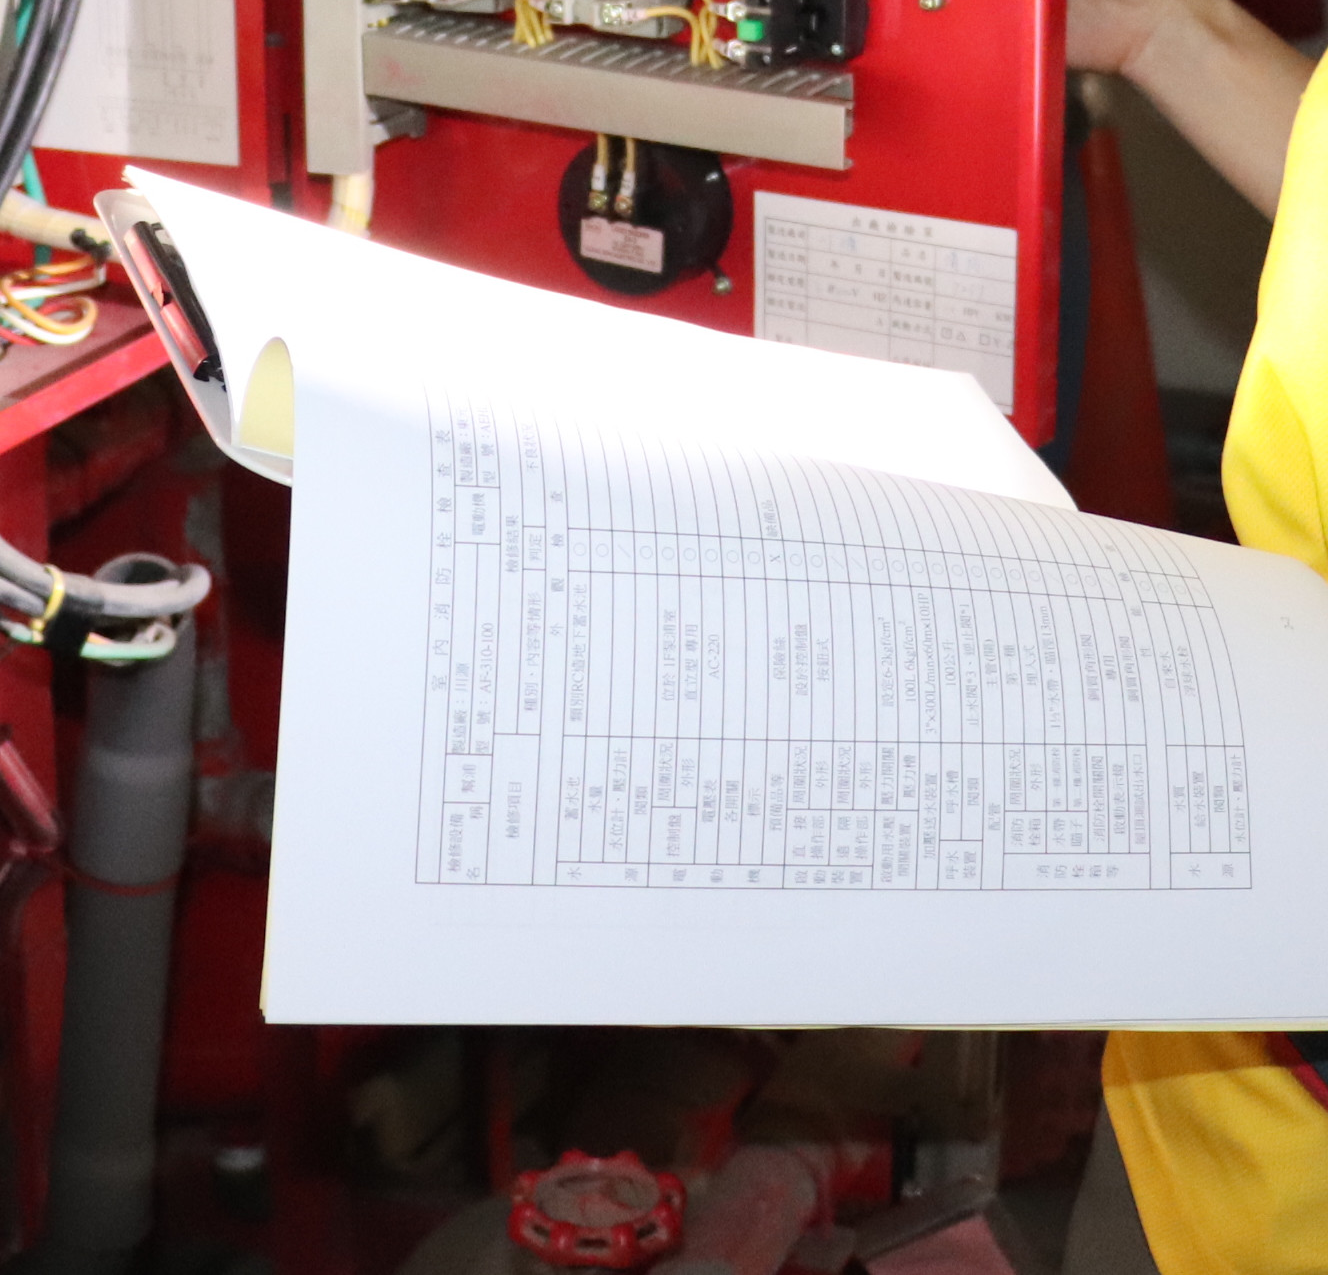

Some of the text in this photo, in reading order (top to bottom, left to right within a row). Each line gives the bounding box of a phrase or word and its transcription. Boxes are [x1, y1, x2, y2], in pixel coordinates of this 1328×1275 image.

[472, 493, 486, 535] 電動機
[505, 515, 520, 573] 檢修結果
[528, 533, 542, 562] 判定
[707, 633, 720, 680] AC-220
[658, 743, 674, 802] 周圍狀況
[681, 758, 695, 787] 外形
[792, 745, 808, 804] 周圍狀況
[815, 760, 829, 789] 外形
[836, 746, 851, 804] 周圍狀況
[859, 761, 872, 790] 外形
[880, 747, 895, 805] 壓力開關
[902, 753, 917, 799] 壓力槽
[1009, 748, 1022, 806] 周圍狀況
[1030, 763, 1043, 791] 外形
[505, 781, 522, 839] 檢修項目
[564, 776, 580, 821] 蓄水池
[588, 786, 603, 814] 水量
[702, 778, 718, 823] 電壓表
[724, 780, 740, 824] 各開關
[747, 787, 761, 817] 標示
[769, 773, 784, 832] 預備品等
[923, 772, 938, 860] 加壓送水裝置
[987, 802, 1001, 831] 配管
[1173, 785, 1186, 813] 水質
[1192, 771, 1206, 828] 給水裝置
[448, 813, 465, 873] 檢修設備
[666, 813, 681, 857] 控制盤
[810, 815, 825, 860] 操作部
[856, 816, 869, 860] 操作部
[1010, 818, 1024, 846] 消防
